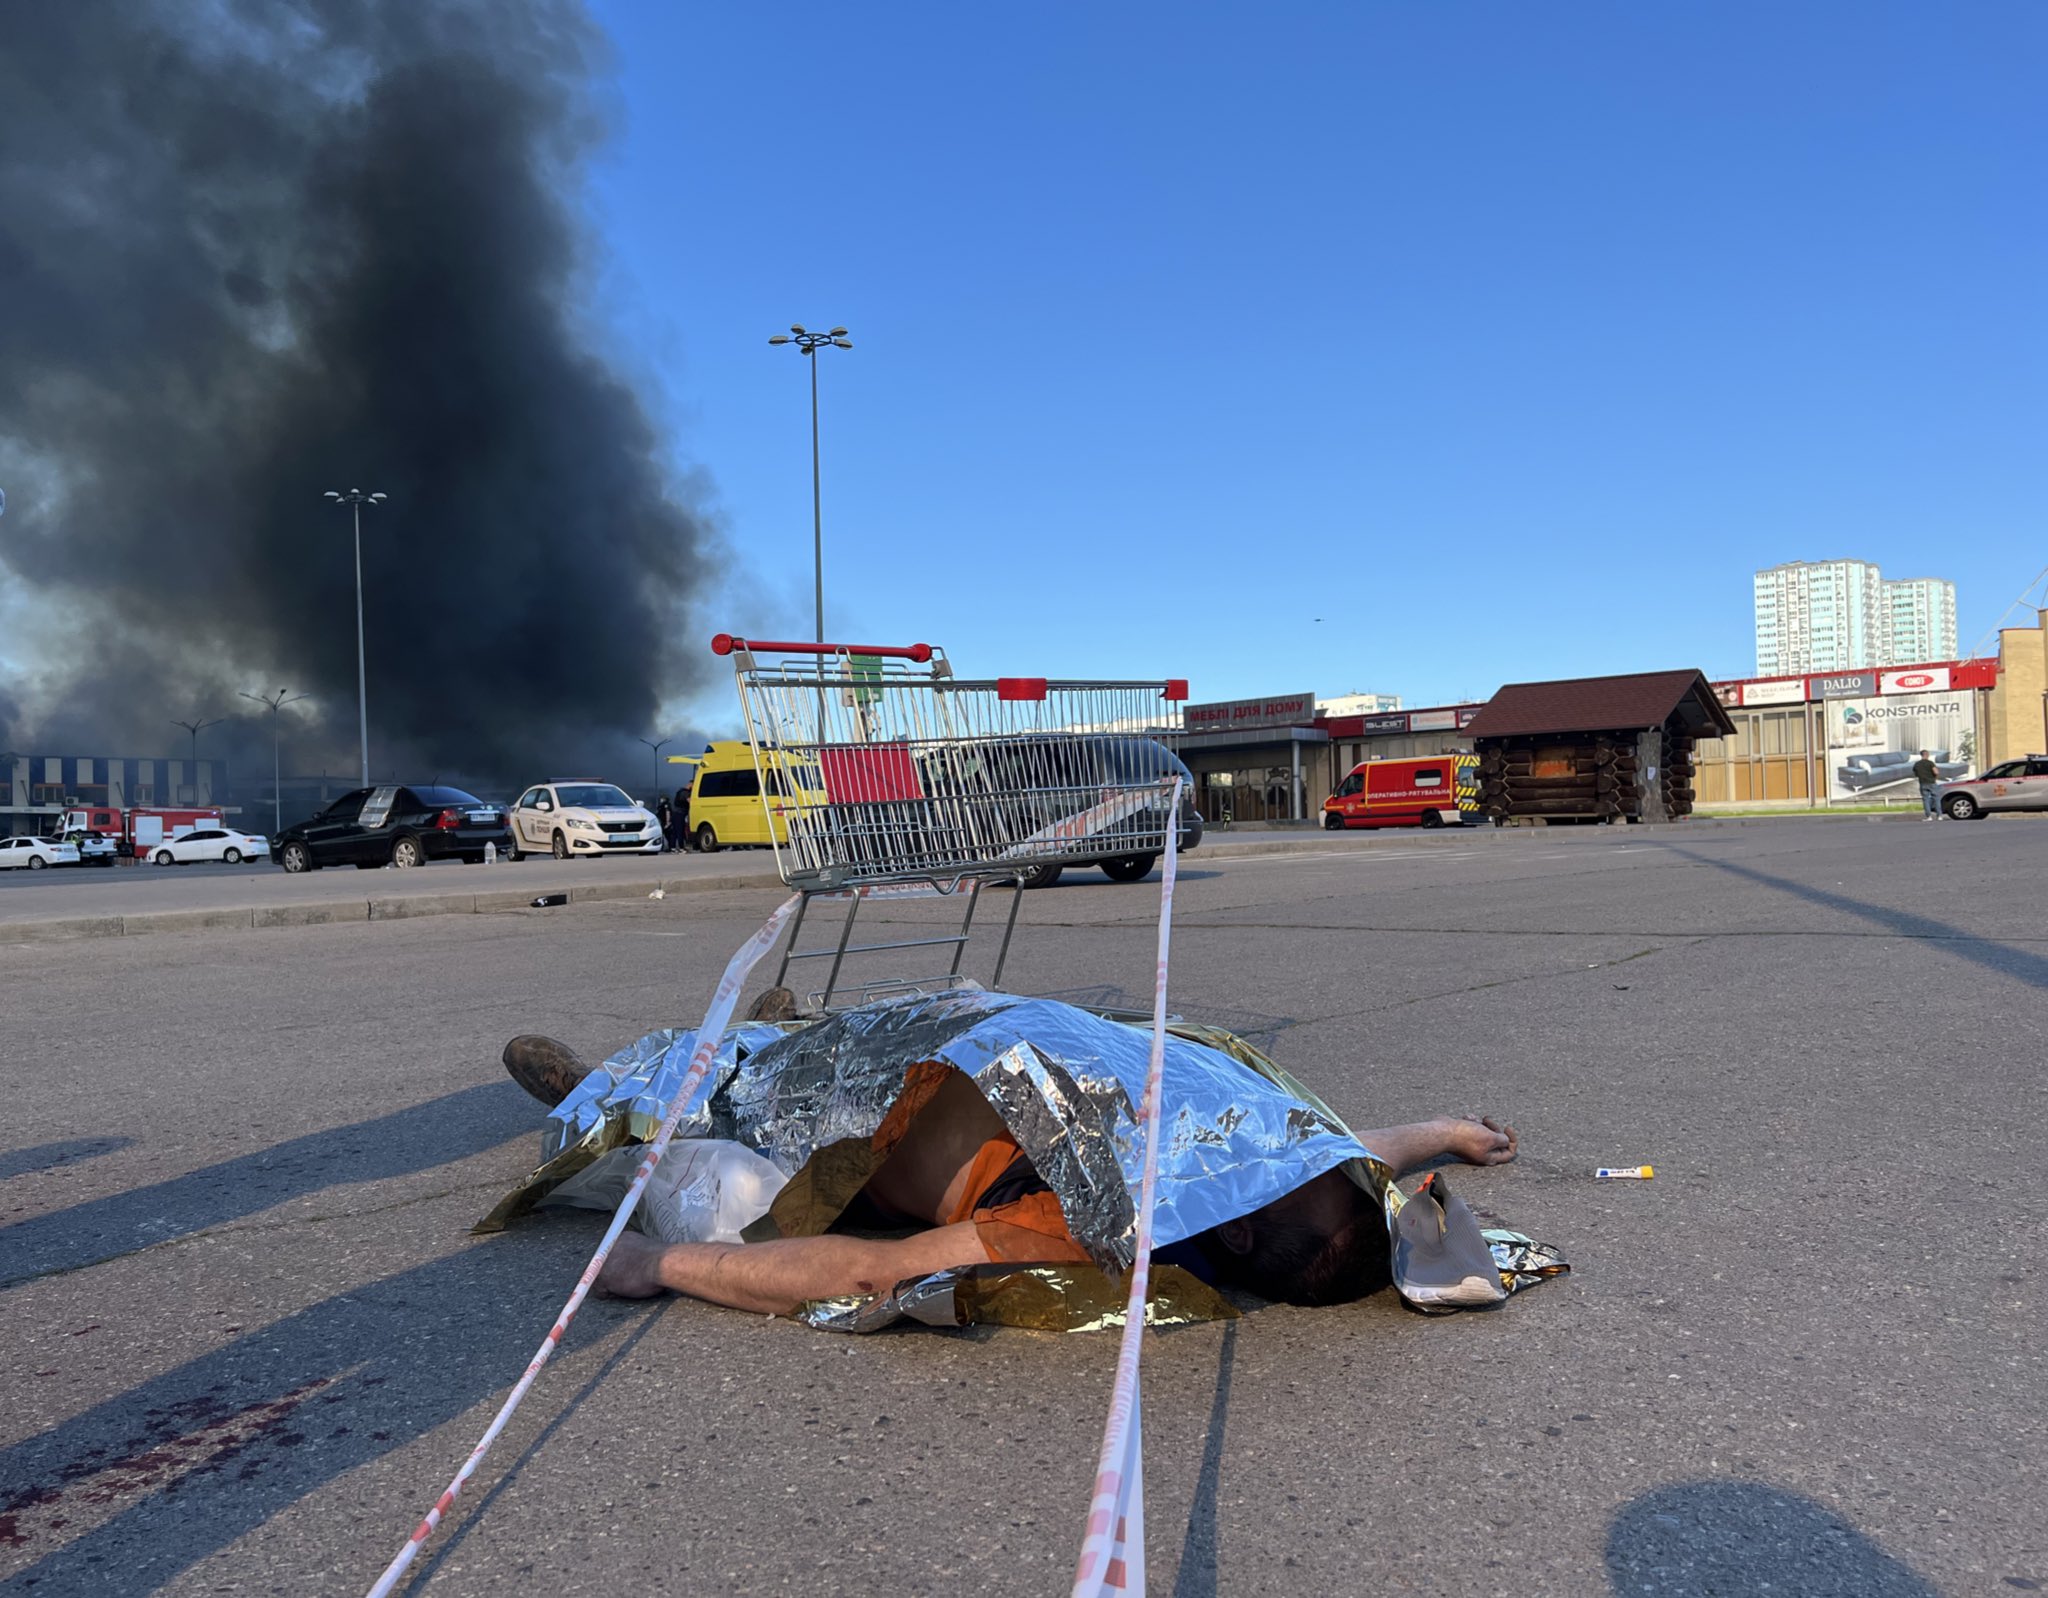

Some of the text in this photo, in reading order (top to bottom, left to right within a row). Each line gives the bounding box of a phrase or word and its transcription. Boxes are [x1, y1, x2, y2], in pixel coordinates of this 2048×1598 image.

[1823, 677, 1862, 690] DALIO
[1190, 700, 1305, 722] МЕБЛІ ДЛЯ ДОМУ
[1865, 702, 1960, 718] KONSTANTA
